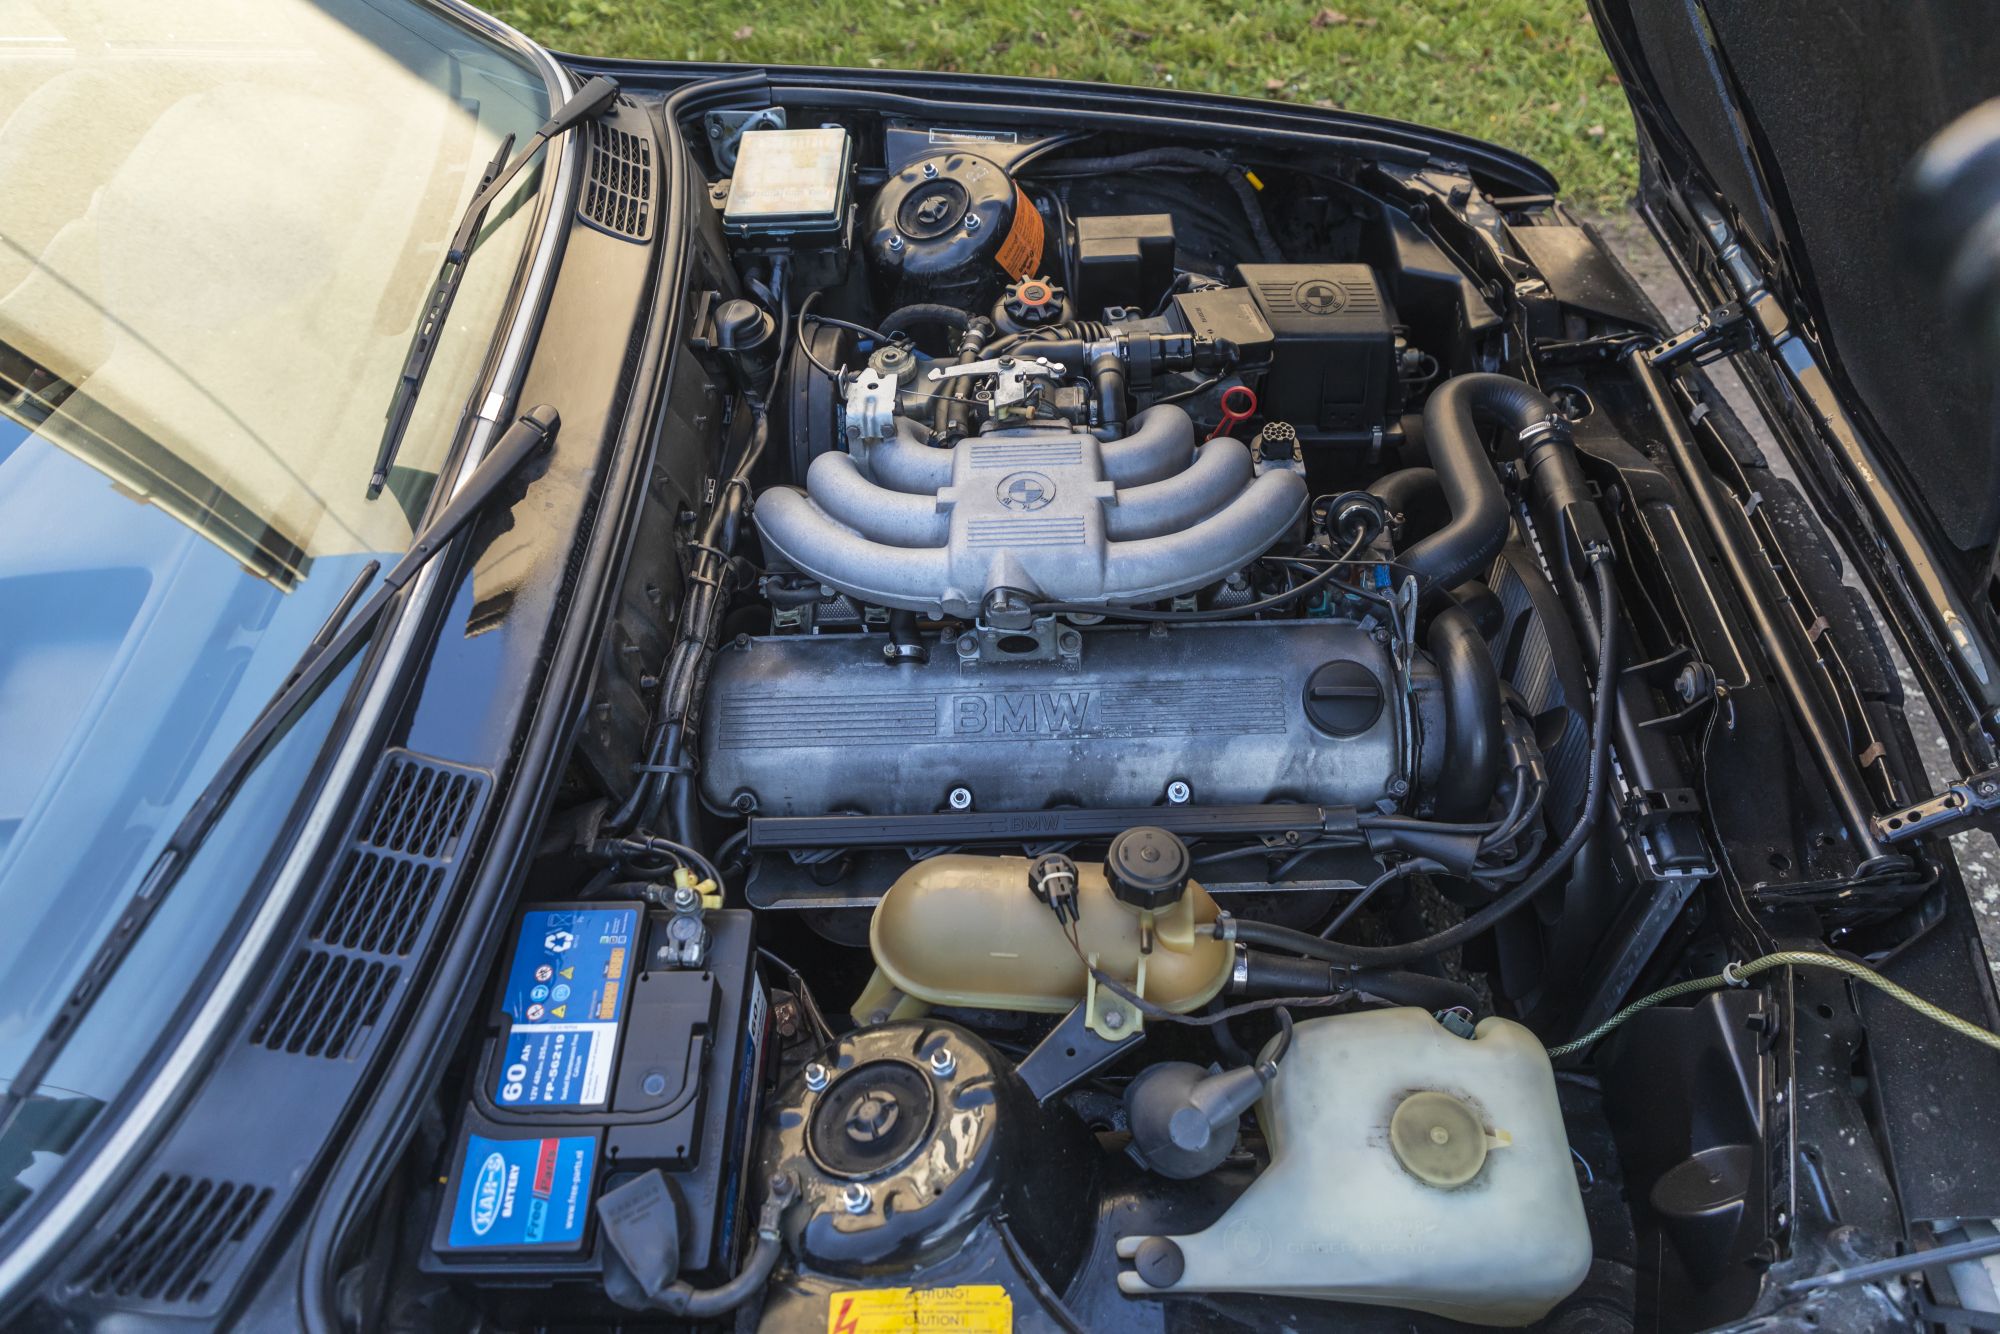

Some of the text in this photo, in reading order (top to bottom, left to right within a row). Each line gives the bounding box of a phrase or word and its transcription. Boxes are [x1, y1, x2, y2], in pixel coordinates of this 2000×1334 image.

[952, 692, 1090, 735] BMW
[1010, 814, 1062, 832] BMW
[502, 1044, 532, 1101] 60 Ah
[543, 1033, 565, 1101] FP-56219
[501, 1163, 520, 1218] BATTERY
[526, 1149, 556, 1239] Free Parts
[565, 1150, 584, 1230] www.free-parts.nl
